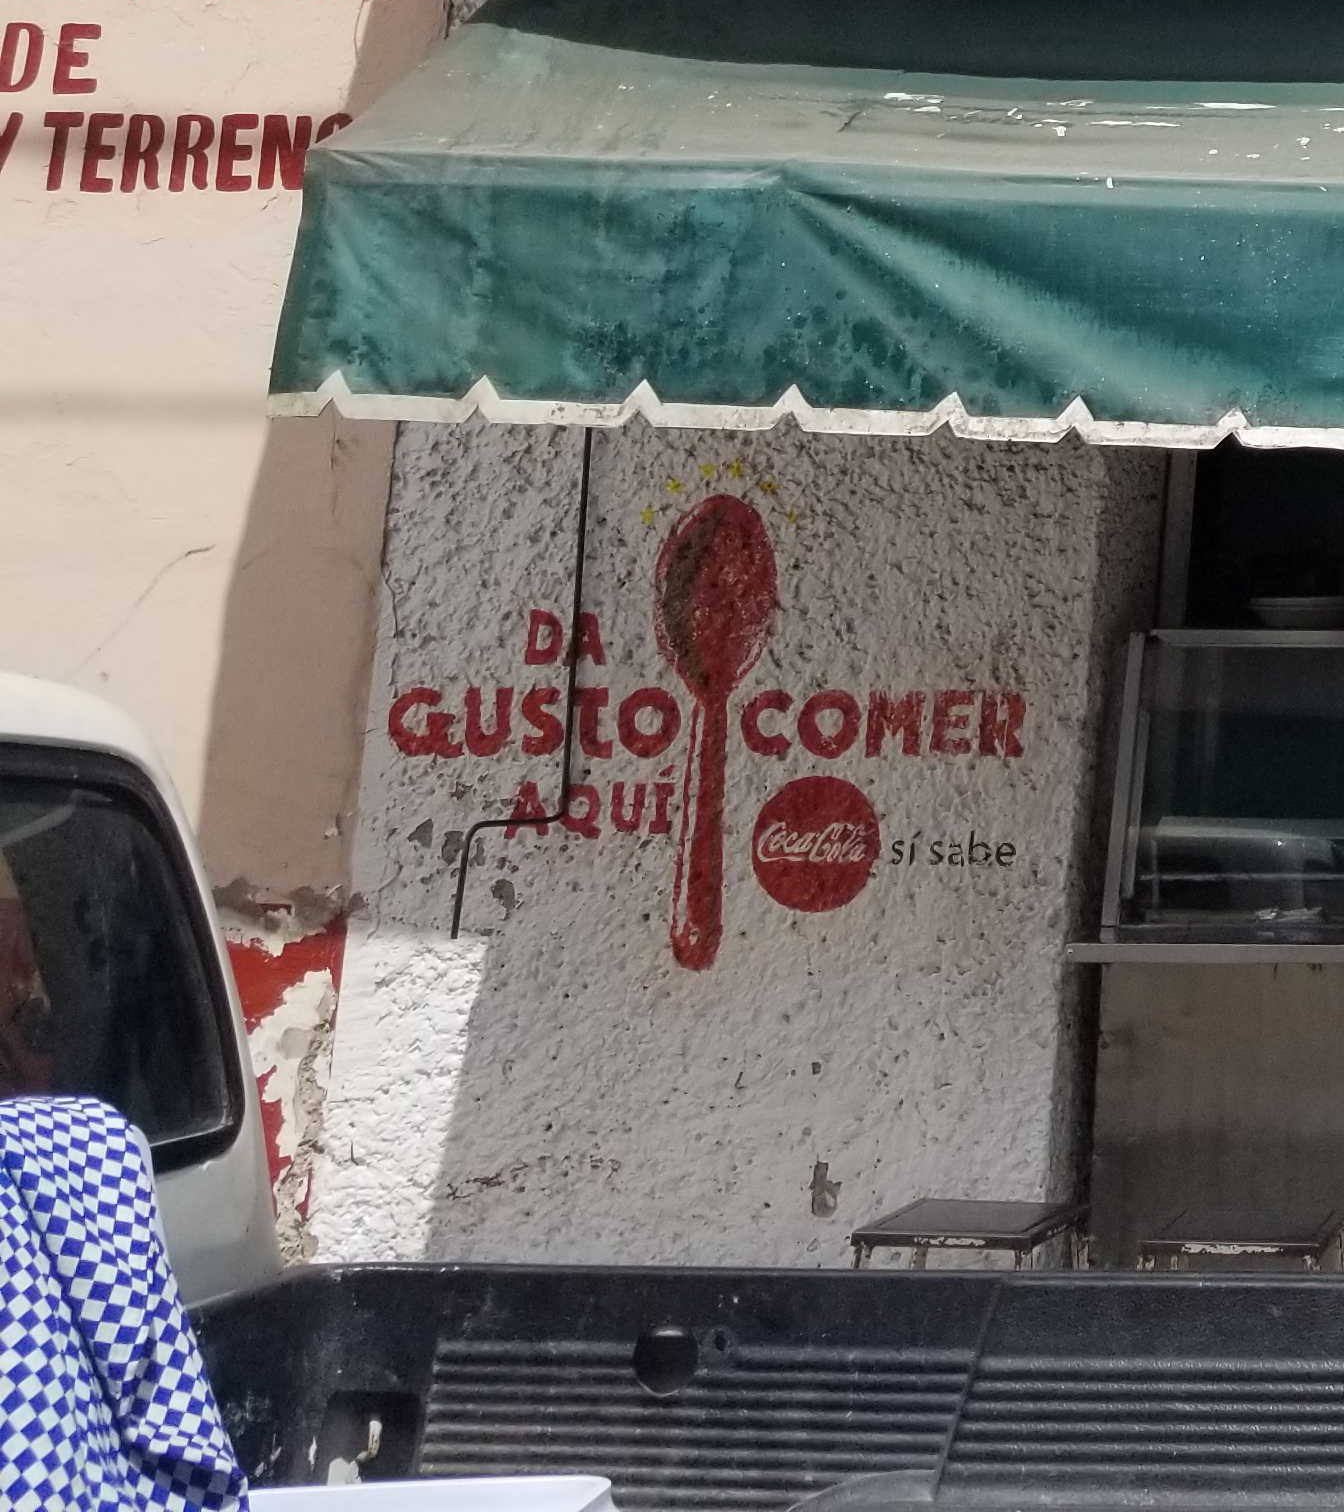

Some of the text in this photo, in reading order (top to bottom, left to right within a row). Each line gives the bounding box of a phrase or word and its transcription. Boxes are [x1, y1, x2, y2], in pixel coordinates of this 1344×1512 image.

[0, 22, 101, 94] DE
[525, 609, 606, 666] DA
[388, 687, 1027, 759] GUSTO COMER
[503, 765, 676, 839] AQUÍ
[929, 829, 1018, 868] sabe
